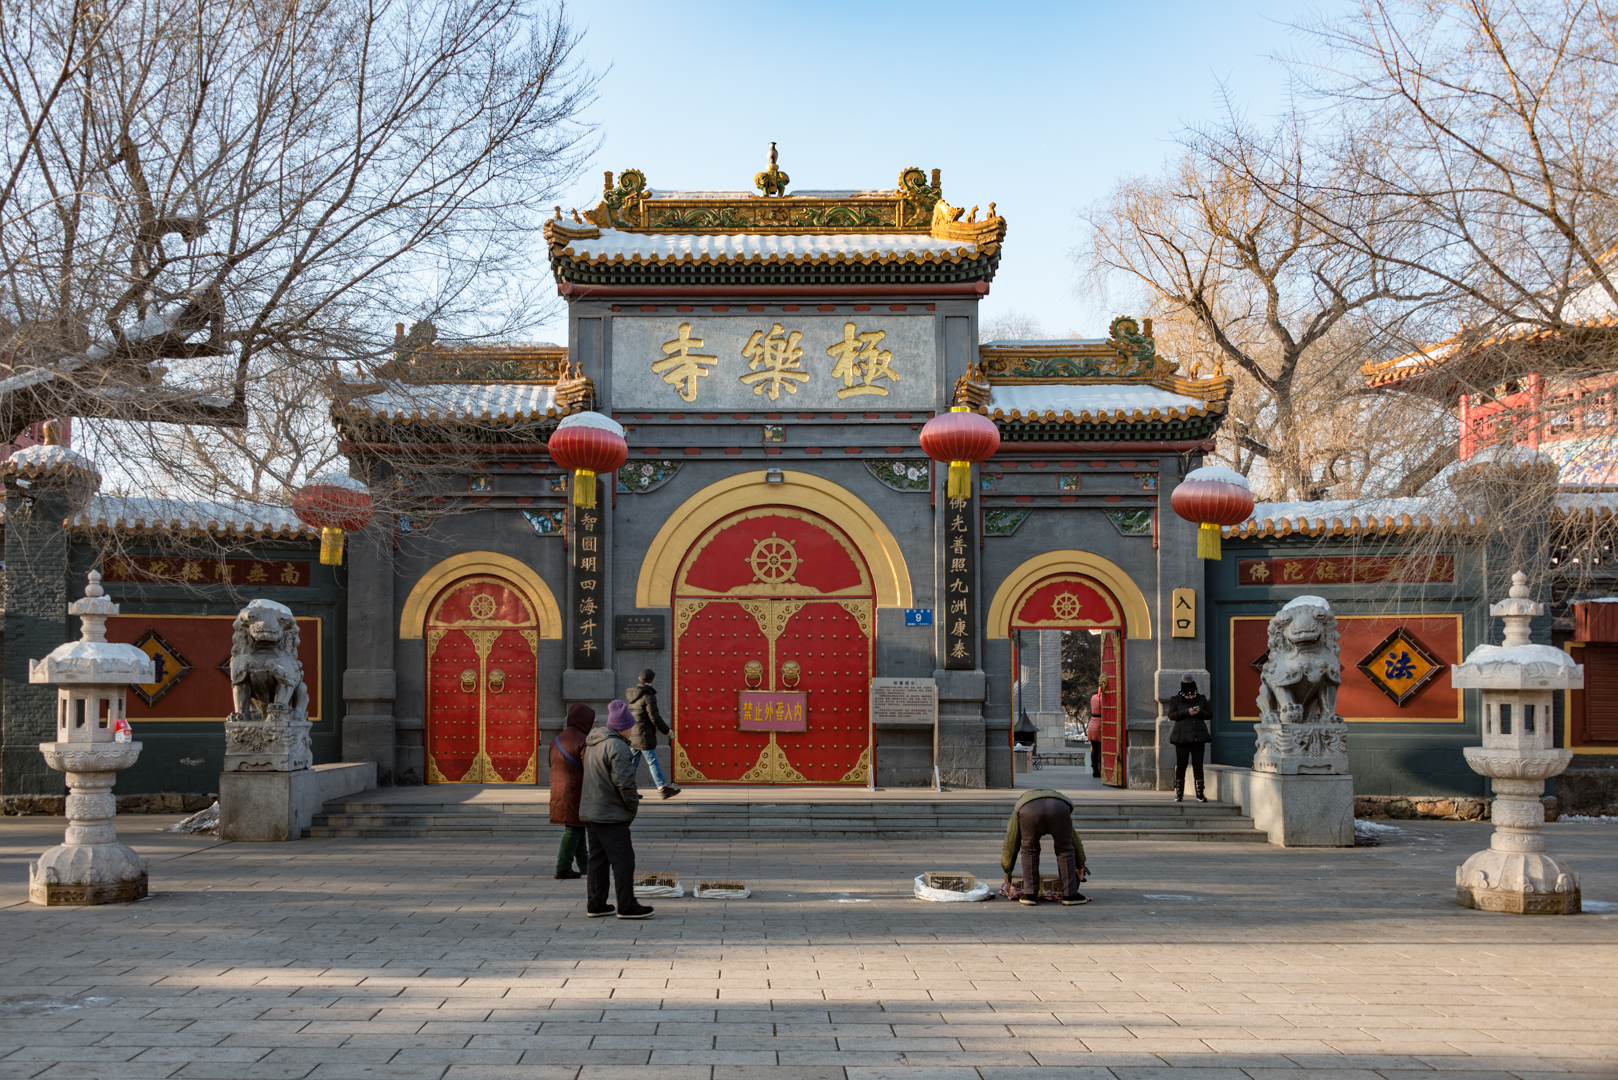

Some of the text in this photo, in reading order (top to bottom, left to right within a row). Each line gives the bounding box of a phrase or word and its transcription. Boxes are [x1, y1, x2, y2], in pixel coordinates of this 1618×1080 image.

[915, 613, 922, 622] 9
[1176, 596, 1192, 629] 入口
[1384, 651, 1417, 680] 法
[743, 701, 802, 722] 禁止外香入内
